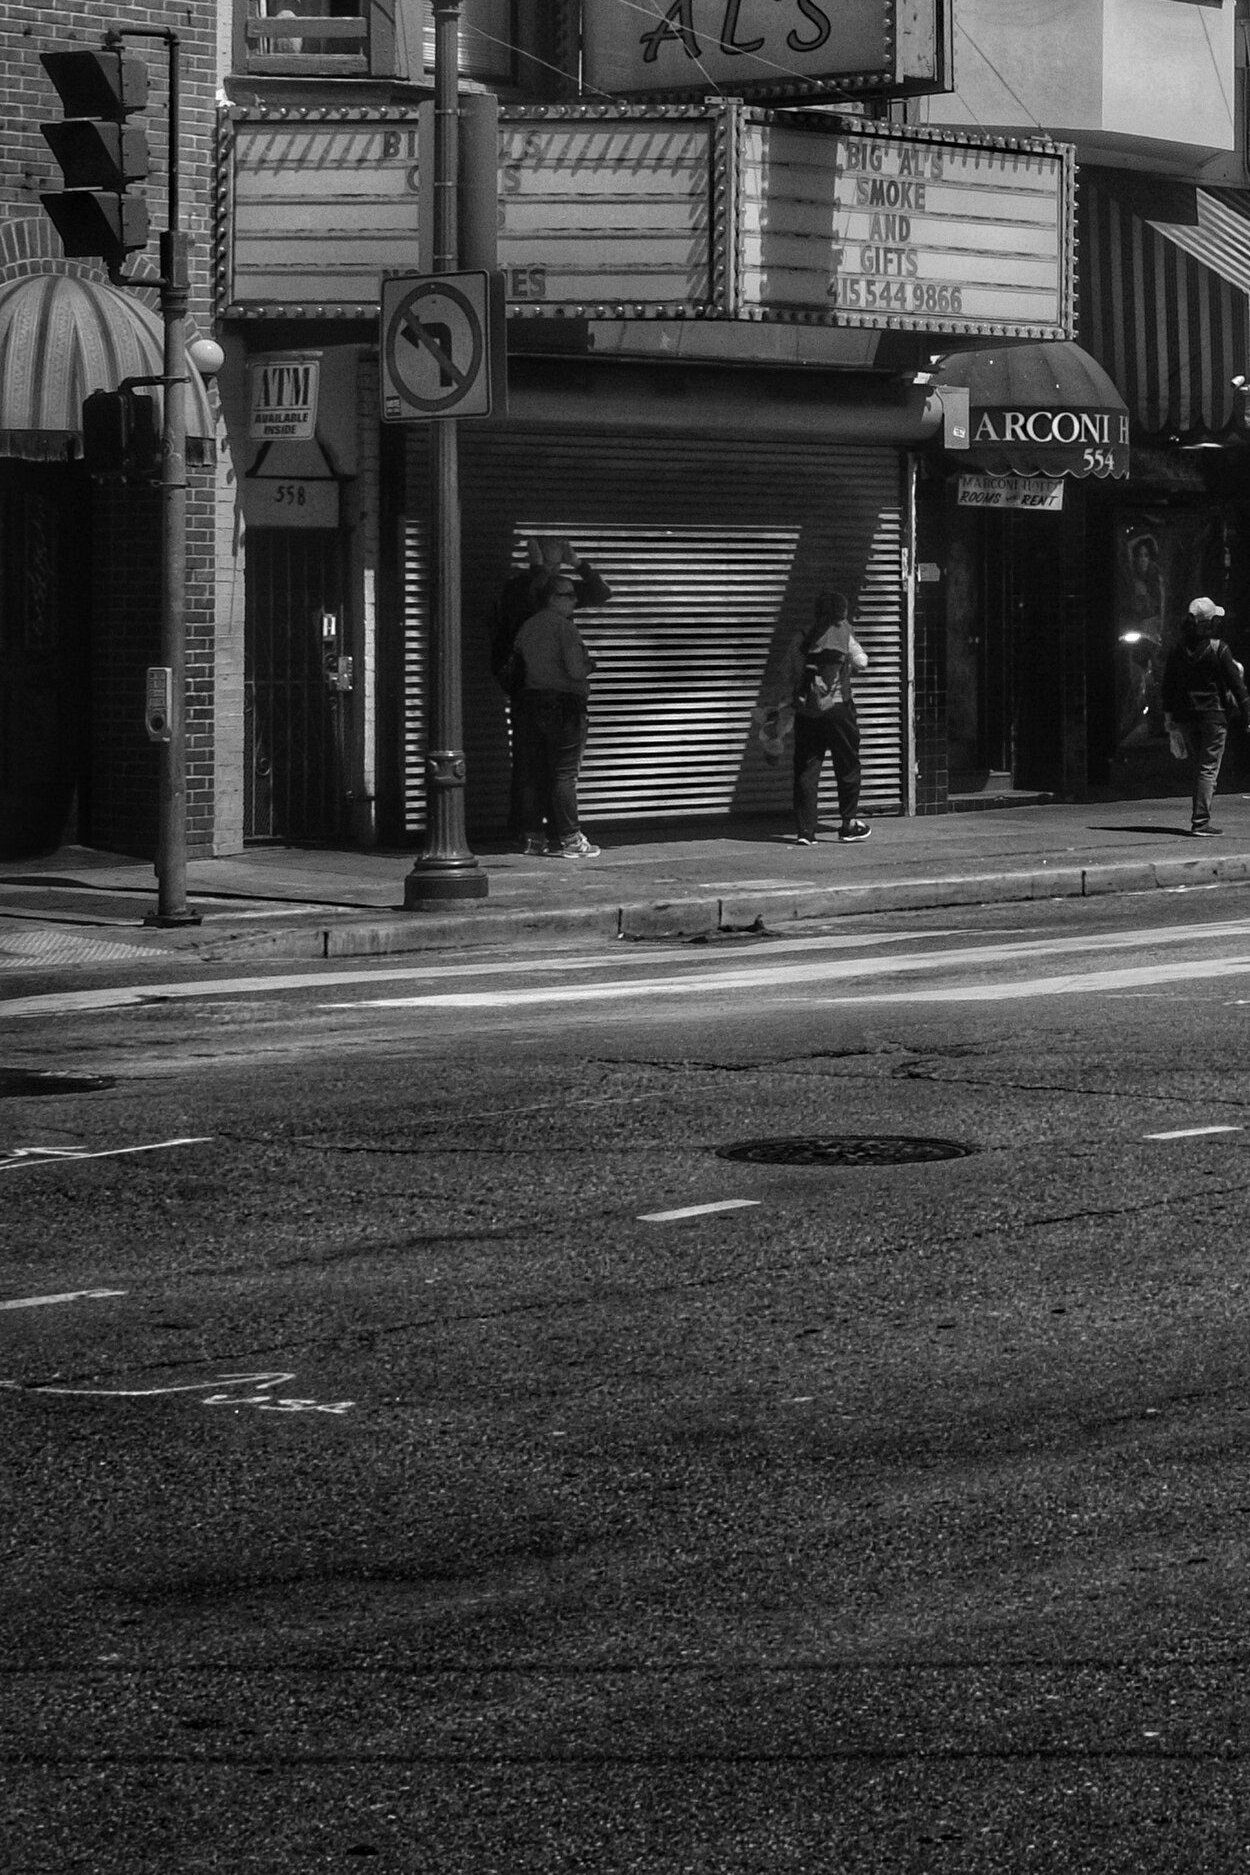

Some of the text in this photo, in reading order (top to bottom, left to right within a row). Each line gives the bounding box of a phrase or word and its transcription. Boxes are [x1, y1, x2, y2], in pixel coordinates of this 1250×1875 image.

[384, 130, 416, 158] BI
[847, 141, 882, 171] BIG
[857, 177, 926, 210] SMOKE
[869, 212, 911, 242] AND
[861, 245, 918, 276] GIFTS
[912, 283, 963, 313] 9866
[255, 367, 310, 407] ATM
[254, 412, 308, 424] AVAILABLE
[263, 424, 297, 435] INSIDE
[971, 410, 1111, 444] ARCONI
[1082, 448, 1116, 472] 554
[274, 485, 307, 506] 558
[960, 491, 1002, 504] ROOMS
[1021, 494, 1059, 506] RENT
